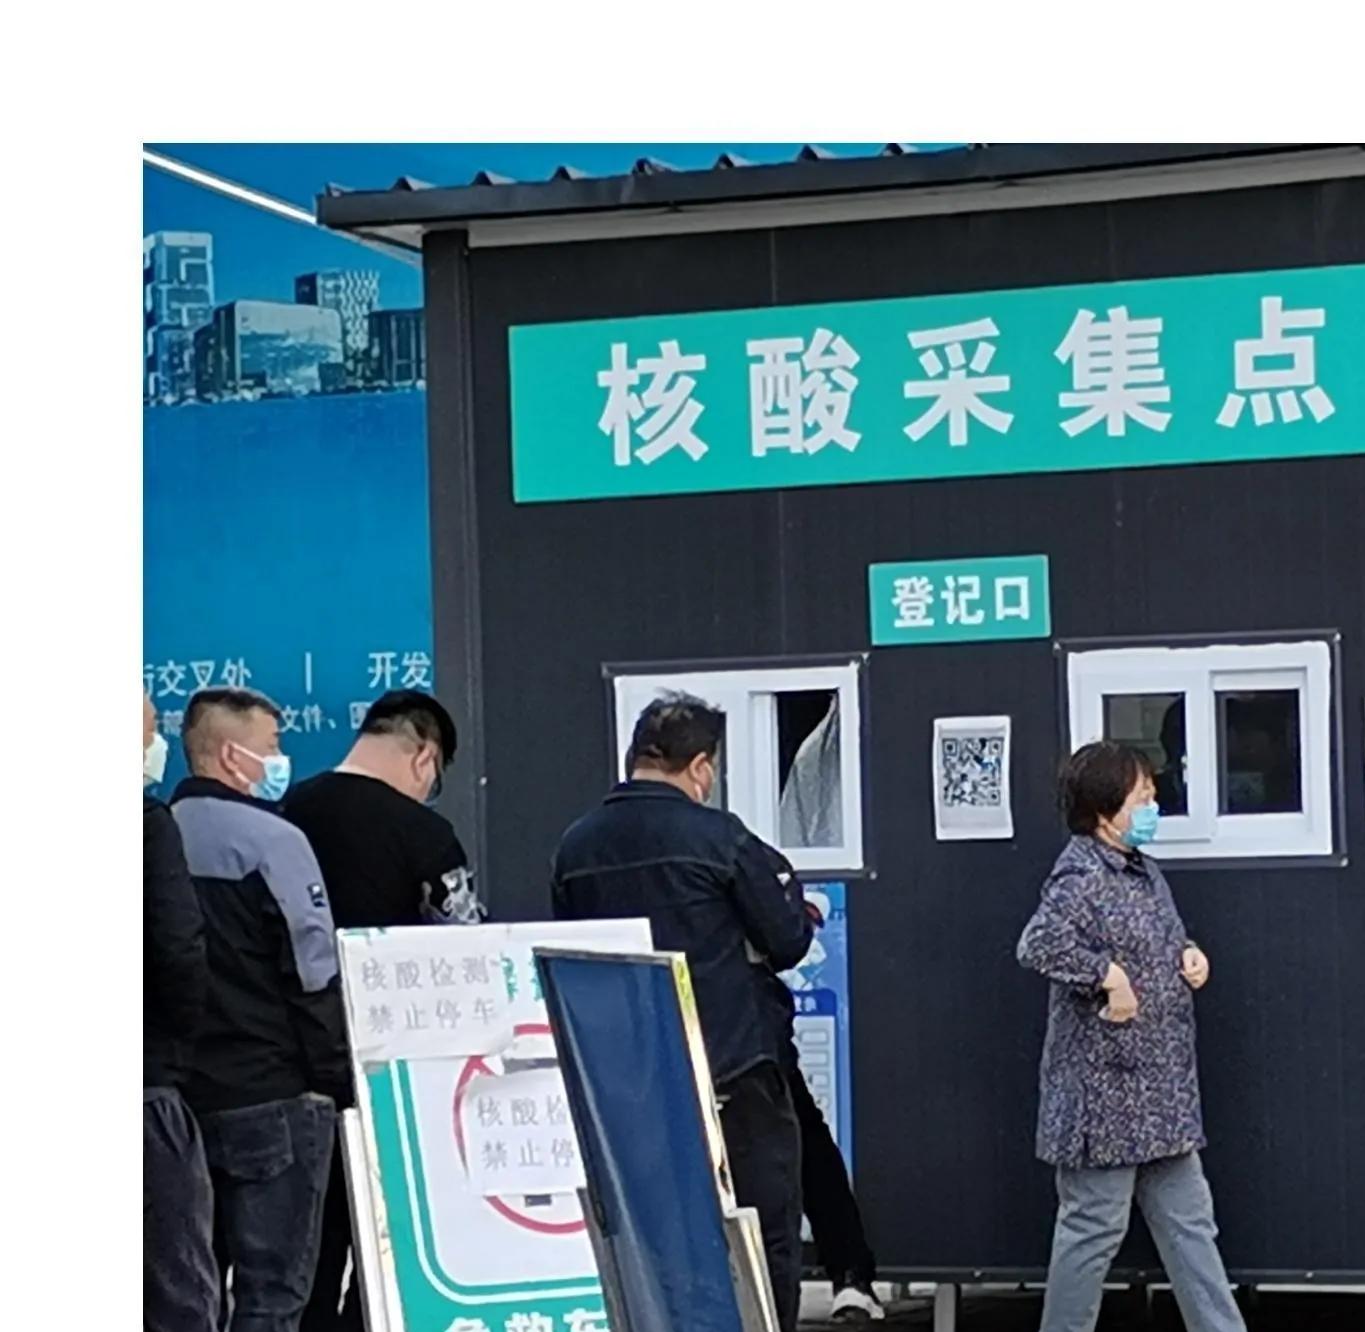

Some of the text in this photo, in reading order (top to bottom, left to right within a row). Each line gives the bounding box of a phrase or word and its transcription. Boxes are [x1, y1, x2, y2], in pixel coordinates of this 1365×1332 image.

[598, 296, 1337, 467] 核酸采集点
[890, 574, 1031, 630] 登记口
[367, 651, 433, 690] 开发
[361, 955, 491, 991] 核酸检测
[368, 997, 497, 1034] 禁止停车
